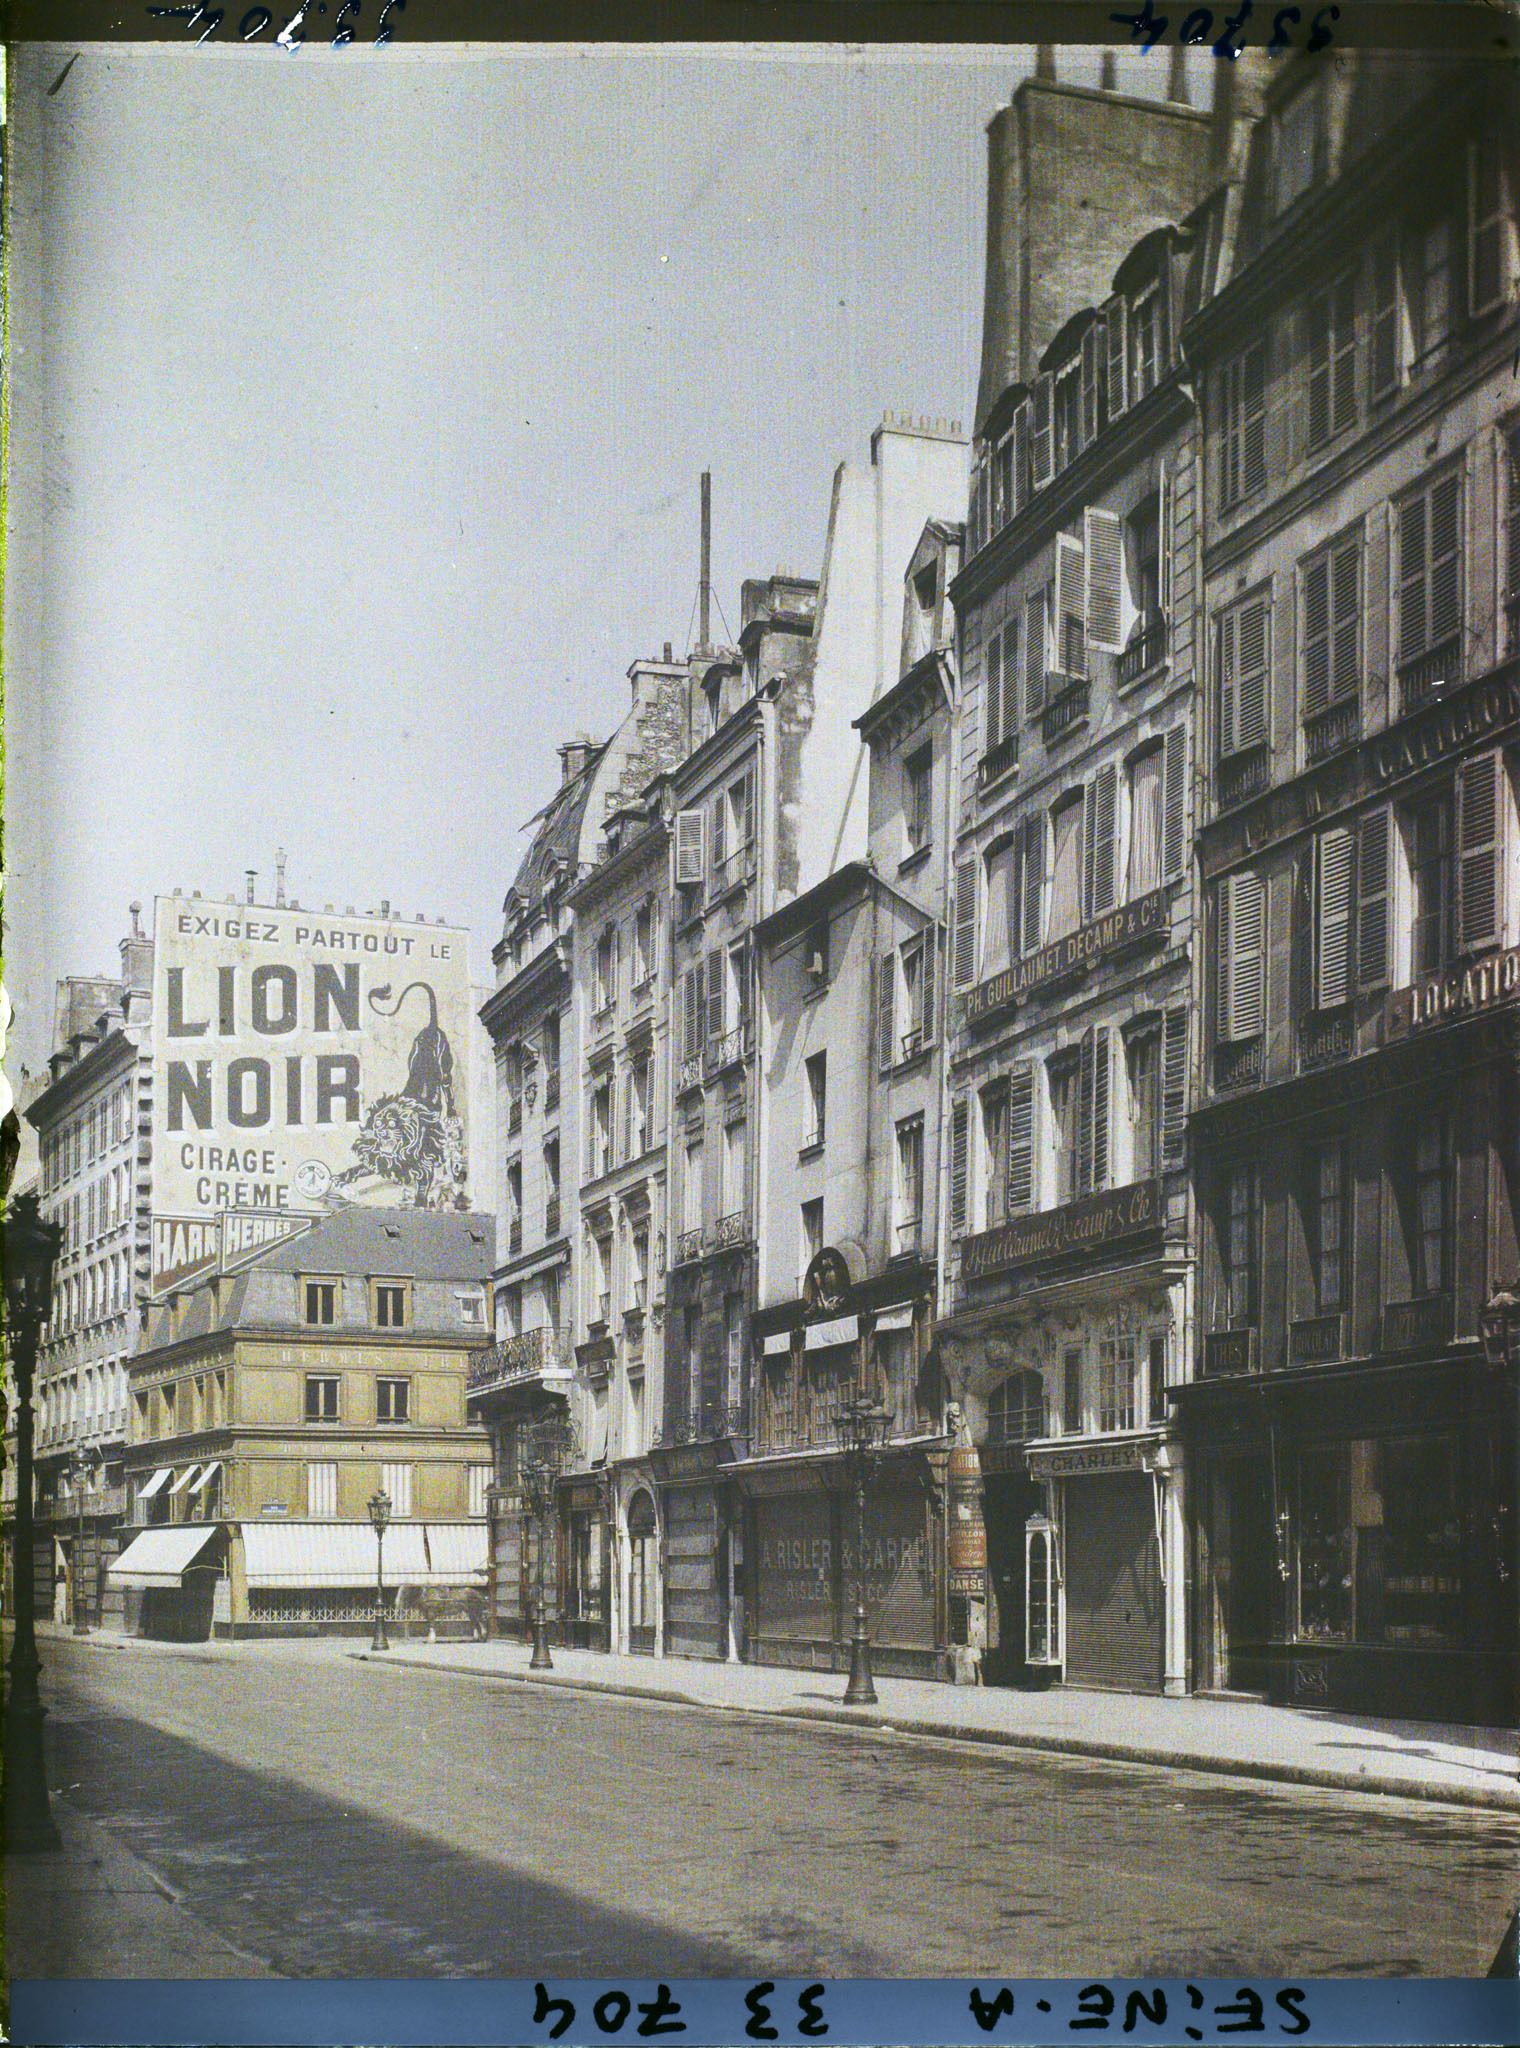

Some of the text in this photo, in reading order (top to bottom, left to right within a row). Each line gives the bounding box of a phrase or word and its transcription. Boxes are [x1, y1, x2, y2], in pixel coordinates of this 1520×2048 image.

[178, 914, 451, 960] EXIGEZ PARTOUT LE
[1067, 914, 1124, 965] DECAMP
[1127, 913, 1136, 932] &
[166, 962, 362, 1038] LION
[166, 1053, 362, 1133] NOIR
[226, 1216, 291, 1256] HERMES
[777, 1538, 832, 1570] RISLER
[841, 1538, 853, 1570] &
[949, 1579, 985, 1590] DANSE
